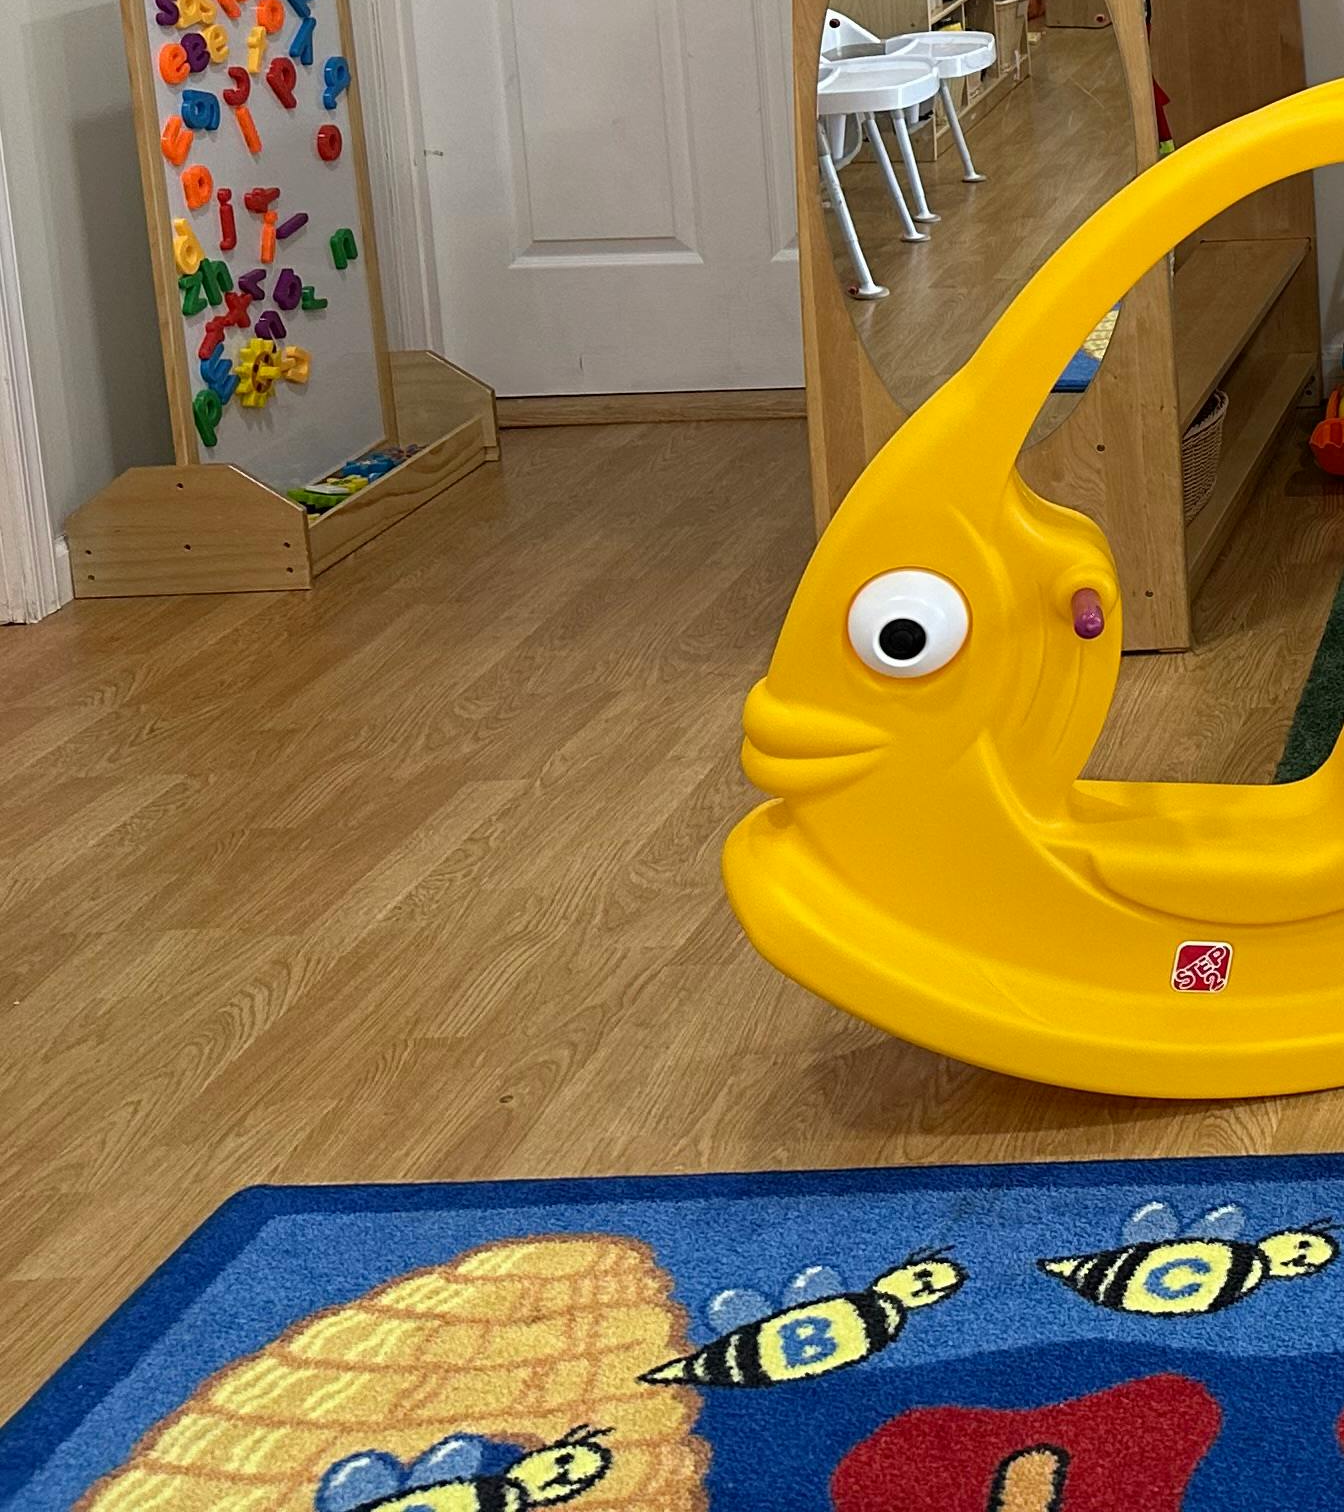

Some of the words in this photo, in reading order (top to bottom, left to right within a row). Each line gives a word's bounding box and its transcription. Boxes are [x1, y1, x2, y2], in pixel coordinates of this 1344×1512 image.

[1175, 945, 1227, 990] STEP
[1204, 970, 1224, 992] 2
[1144, 1256, 1206, 1299] C
[779, 1314, 838, 1372] B
